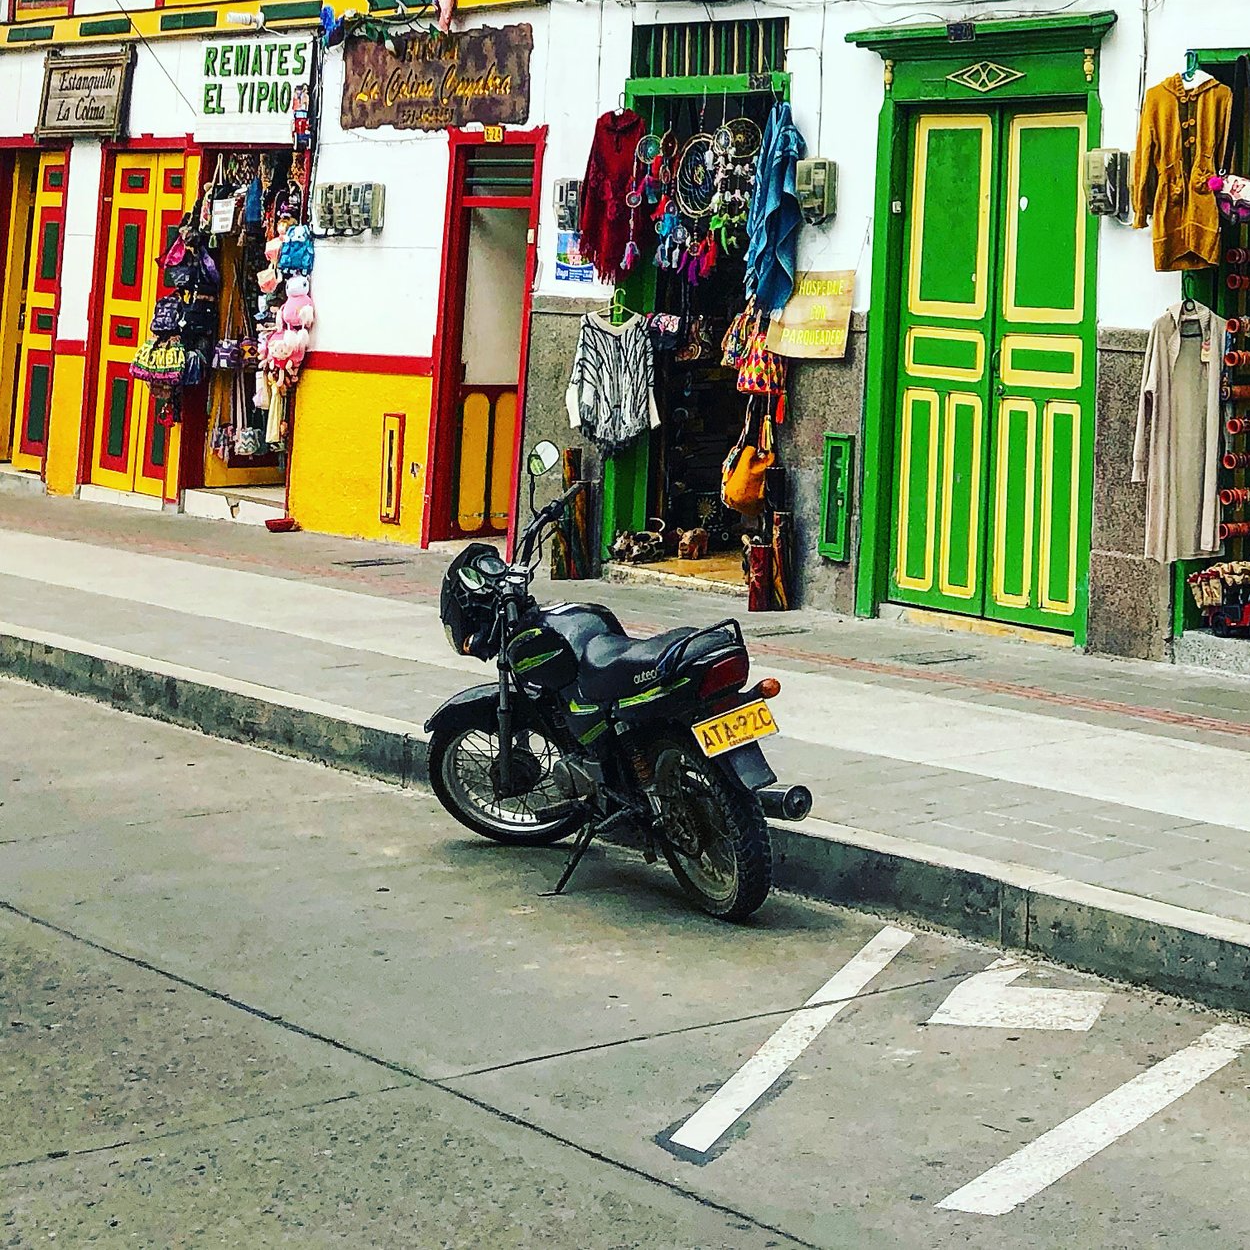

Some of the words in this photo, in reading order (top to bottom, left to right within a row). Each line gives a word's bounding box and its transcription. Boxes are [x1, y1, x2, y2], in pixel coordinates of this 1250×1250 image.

[203, 42, 307, 77] REMATES
[203, 83, 226, 114] EL
[237, 81, 292, 114] YIPAO
[356, 68, 379, 102] La
[384, 66, 435, 107] Colina
[56, 99, 70, 122] La
[75, 96, 105, 121] Colina
[810, 303, 827, 320] CON
[780, 327, 845, 346] PARQUEADERO
